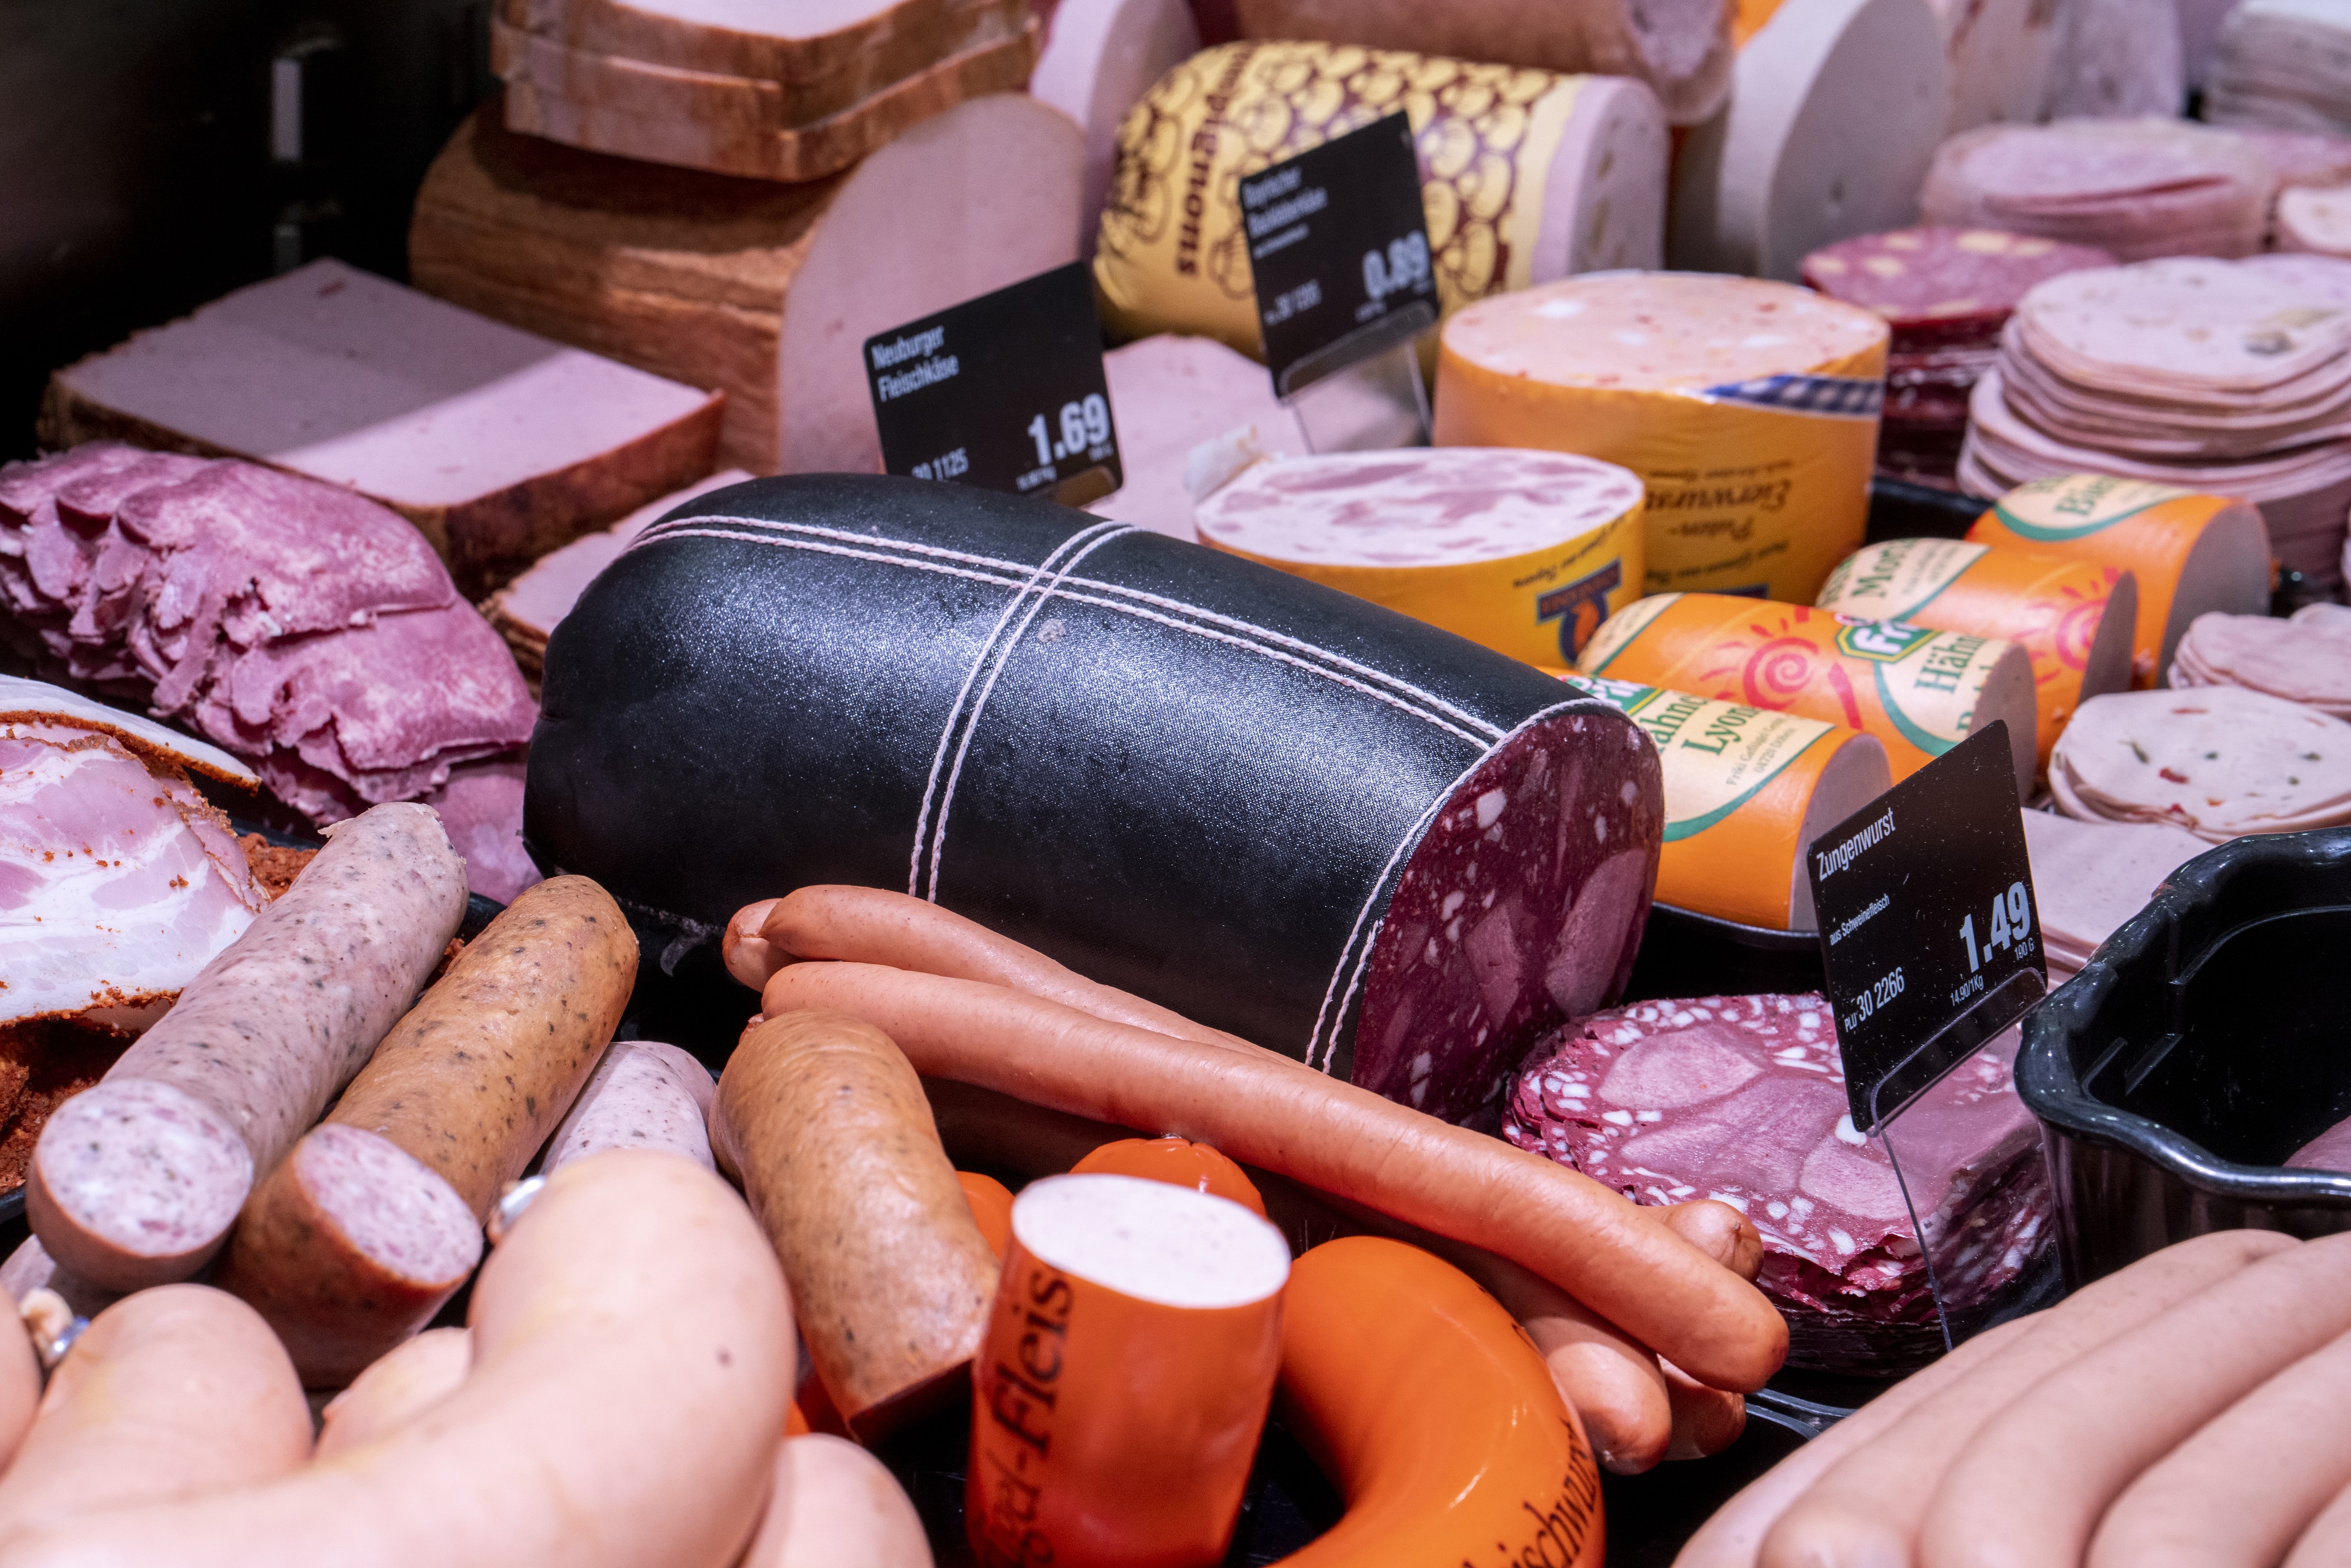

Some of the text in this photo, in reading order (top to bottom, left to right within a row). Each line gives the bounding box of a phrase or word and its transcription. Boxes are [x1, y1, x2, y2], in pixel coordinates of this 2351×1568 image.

[1363, 229, 1432, 299] 0.89
[871, 325, 944, 370] Neuburger
[878, 355, 959, 402] Fleischkäse
[1027, 392, 1111, 466] 1.69
[1816, 807, 1895, 882] Zungenwurst
[1830, 893, 1890, 946] aus Schweinefleisch
[1959, 881, 2030, 973] 1.49
[2014, 937, 2035, 961] 100 G
[1844, 967, 1905, 1032] PLU 30 2266
[1950, 975, 1984, 1007] 14.90/1Kg
